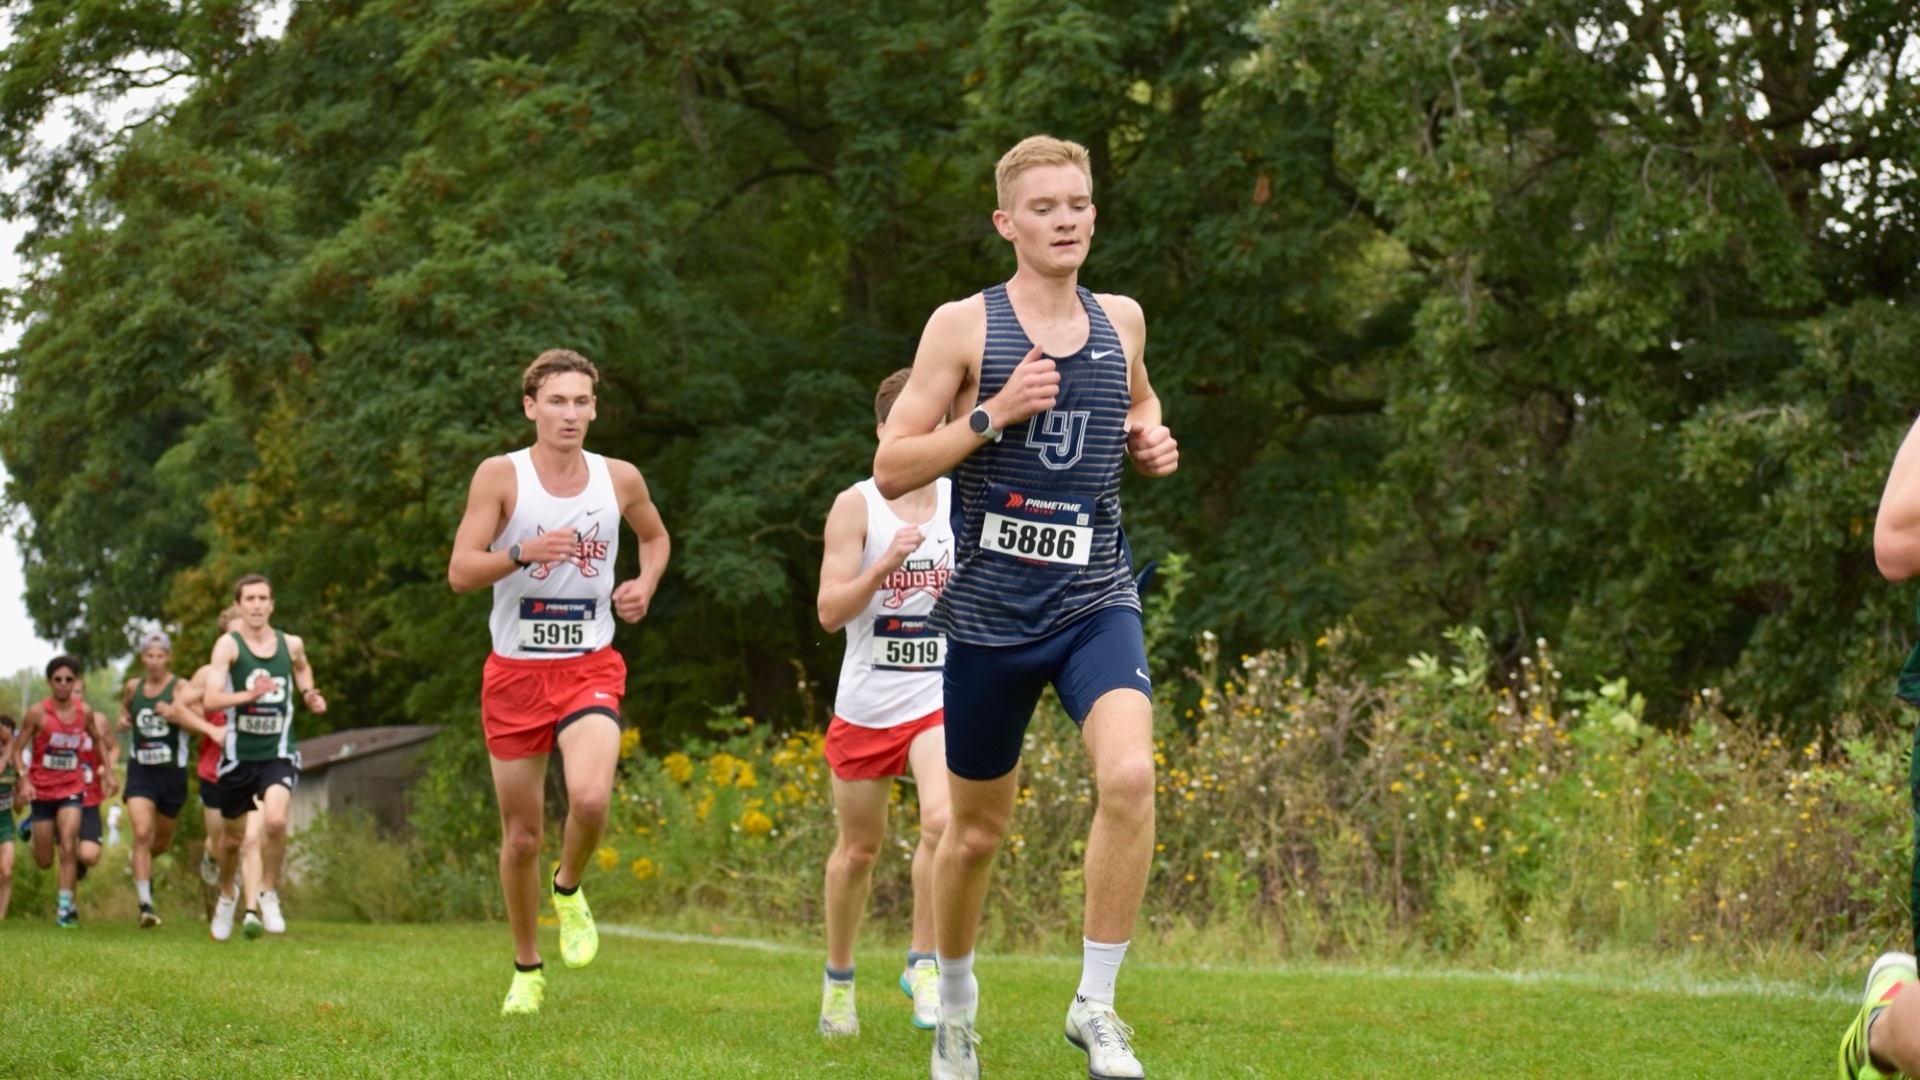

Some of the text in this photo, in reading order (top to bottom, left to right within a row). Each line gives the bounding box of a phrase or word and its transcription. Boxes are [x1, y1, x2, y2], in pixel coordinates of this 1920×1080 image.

[1025, 498, 1081, 512] PRIMETIME
[997, 519, 1077, 559] 5886
[880, 569, 954, 588] AIDER
[533, 623, 583, 645] 5915
[886, 640, 938, 663] 5919
